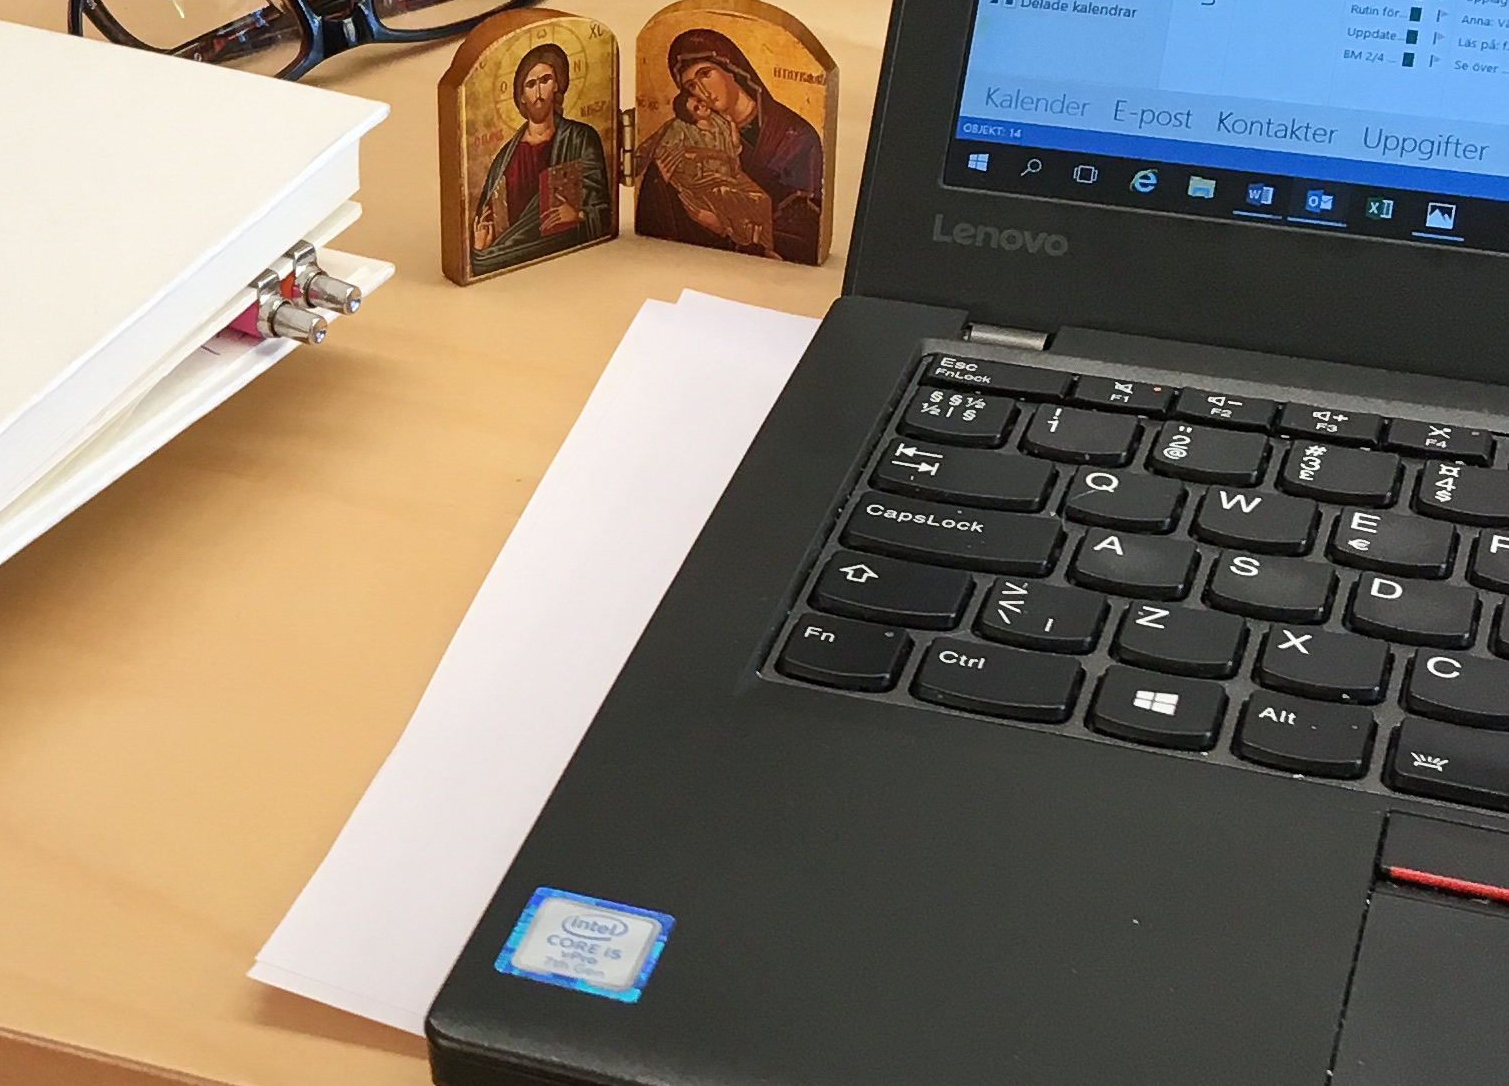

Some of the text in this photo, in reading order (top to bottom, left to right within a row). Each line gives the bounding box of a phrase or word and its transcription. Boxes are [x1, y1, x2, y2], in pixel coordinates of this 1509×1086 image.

[1073, 2, 1137, 18] kalendrar
[1351, 4, 1379, 16] Rutin
[1344, 49, 1384, 63] BM 2/4
[1454, 61, 1468, 70] Se
[985, 86, 1090, 117] Kalender
[1113, 99, 1194, 130] E-post
[963, 122, 1022, 140] OBJEKT: 14
[1217, 111, 1338, 145] Kontakter
[1363, 126, 1489, 162] Uppgifter
[932, 215, 1068, 257] Lenovo
[940, 357, 978, 371] Esc
[936, 368, 991, 384] FnLock
[1110, 393, 1129, 403] F1
[1047, 419, 1059, 432] 1
[1315, 422, 1338, 433] F3
[1172, 435, 1191, 449] 2
[1425, 438, 1447, 449] F4
[1301, 456, 1321, 471] 3
[1085, 472, 1119, 492] Q
[1435, 477, 1457, 491] 4
[1220, 490, 1262, 513] W
[866, 504, 984, 533] CapsLock
[1351, 512, 1381, 534] E
[1094, 535, 1124, 556] A
[1230, 556, 1260, 576] S
[1370, 577, 1403, 599] D
[1135, 605, 1170, 629] Z
[804, 626, 836, 643] Fn
[1277, 629, 1313, 655] X
[939, 651, 985, 669] Ctrl
[1426, 656, 1462, 679] C
[1258, 707, 1296, 726] Alt
[570, 916, 617, 936] intel
[547, 934, 601, 954] CORE
